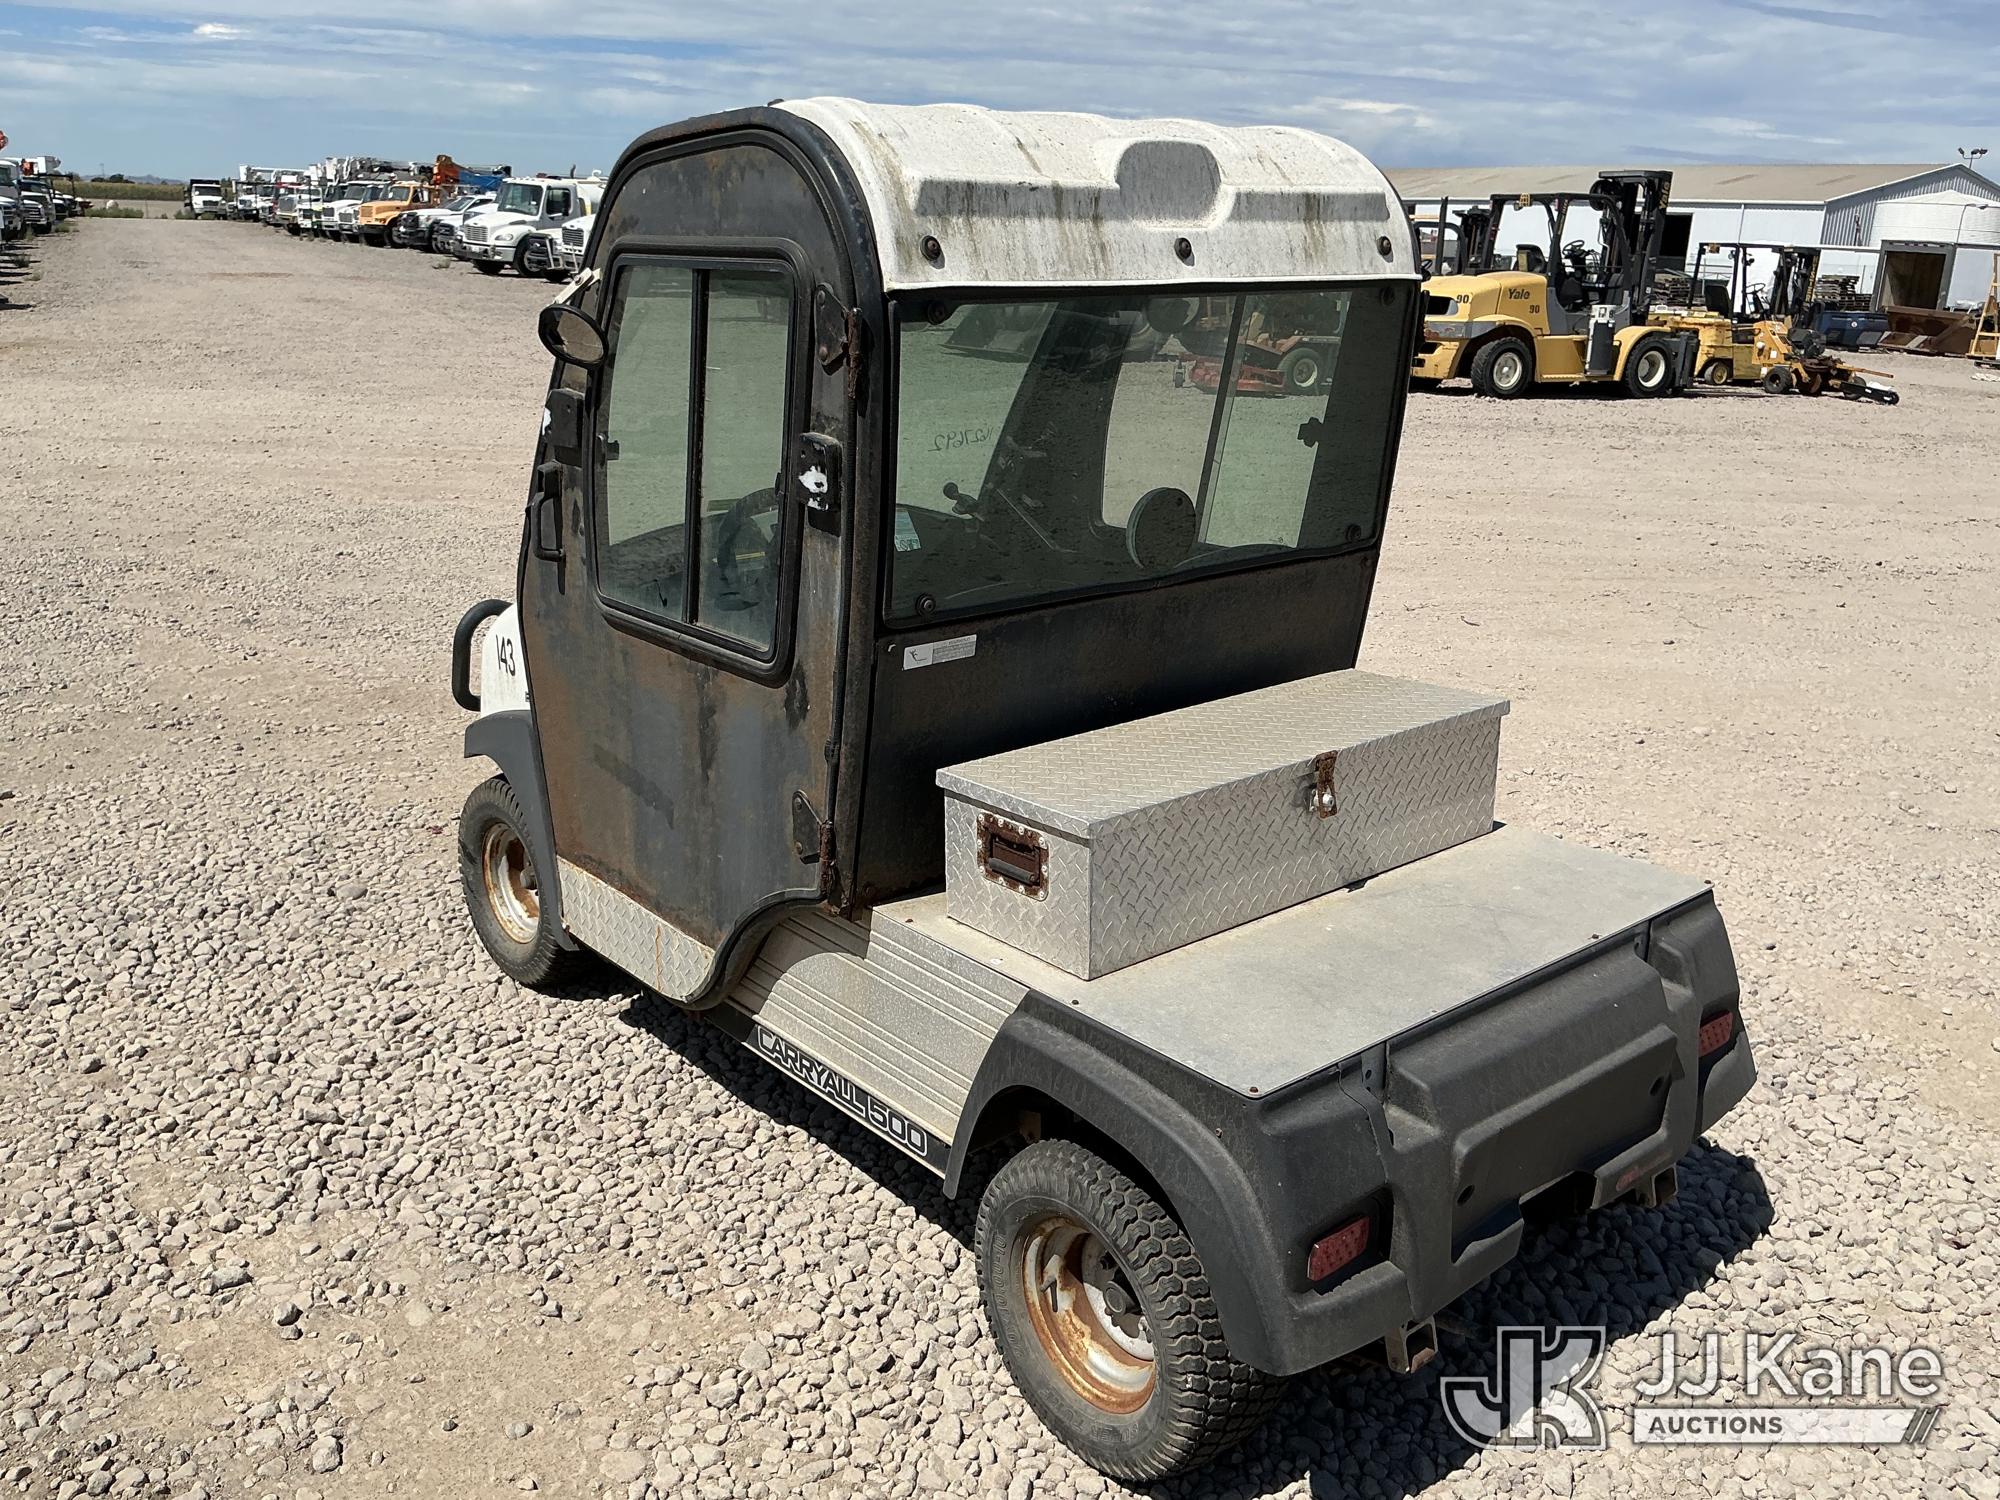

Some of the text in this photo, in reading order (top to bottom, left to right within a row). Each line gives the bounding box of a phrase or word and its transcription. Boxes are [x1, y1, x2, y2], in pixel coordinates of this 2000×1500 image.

[1658, 181, 1671, 209] Yale
[1456, 294, 1470, 304] 90
[1508, 288, 1531, 300] Yale
[1529, 304, 1540, 314] 90
[495, 634, 516, 677] 143
[757, 1025, 928, 1157] CARRYALL 500
